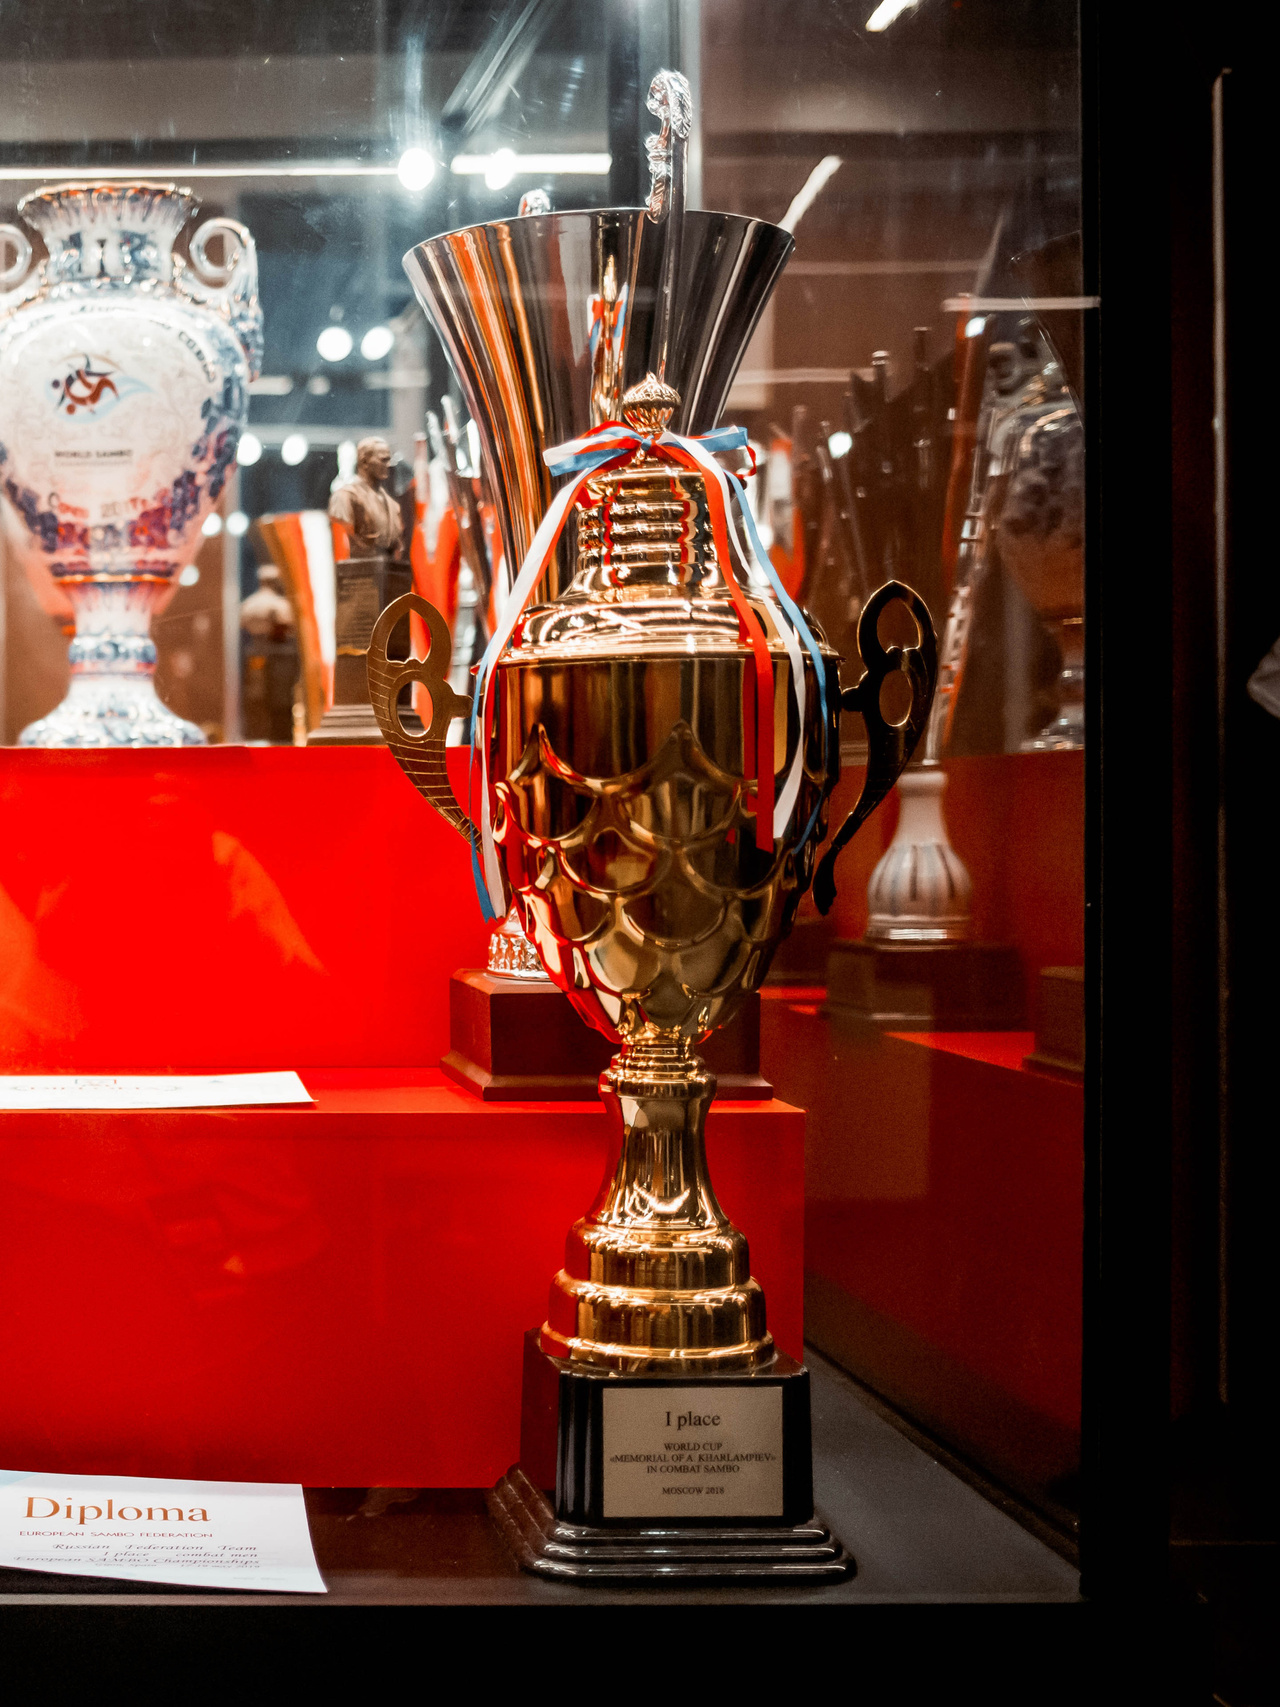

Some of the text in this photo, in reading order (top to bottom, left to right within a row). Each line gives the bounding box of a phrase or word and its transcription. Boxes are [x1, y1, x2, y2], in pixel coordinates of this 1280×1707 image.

[665, 1411, 721, 1431] I place
[664, 1442, 723, 1451] WORLD CUP
[609, 1454, 669, 1463] «MEMORIAL
[671, 1454, 685, 1463] OF
[646, 1464, 740, 1474] IN COMBAT SAMBO
[662, 1486, 725, 1495] MOSCOW 2018
[22, 1496, 212, 1525] Diploma
[19, 1530, 84, 1538] EUROPEAN
[124, 1543, 204, 1551] Federation
[113, 1550, 150, 1558] place
[153, 1557, 260, 1566] Championships
